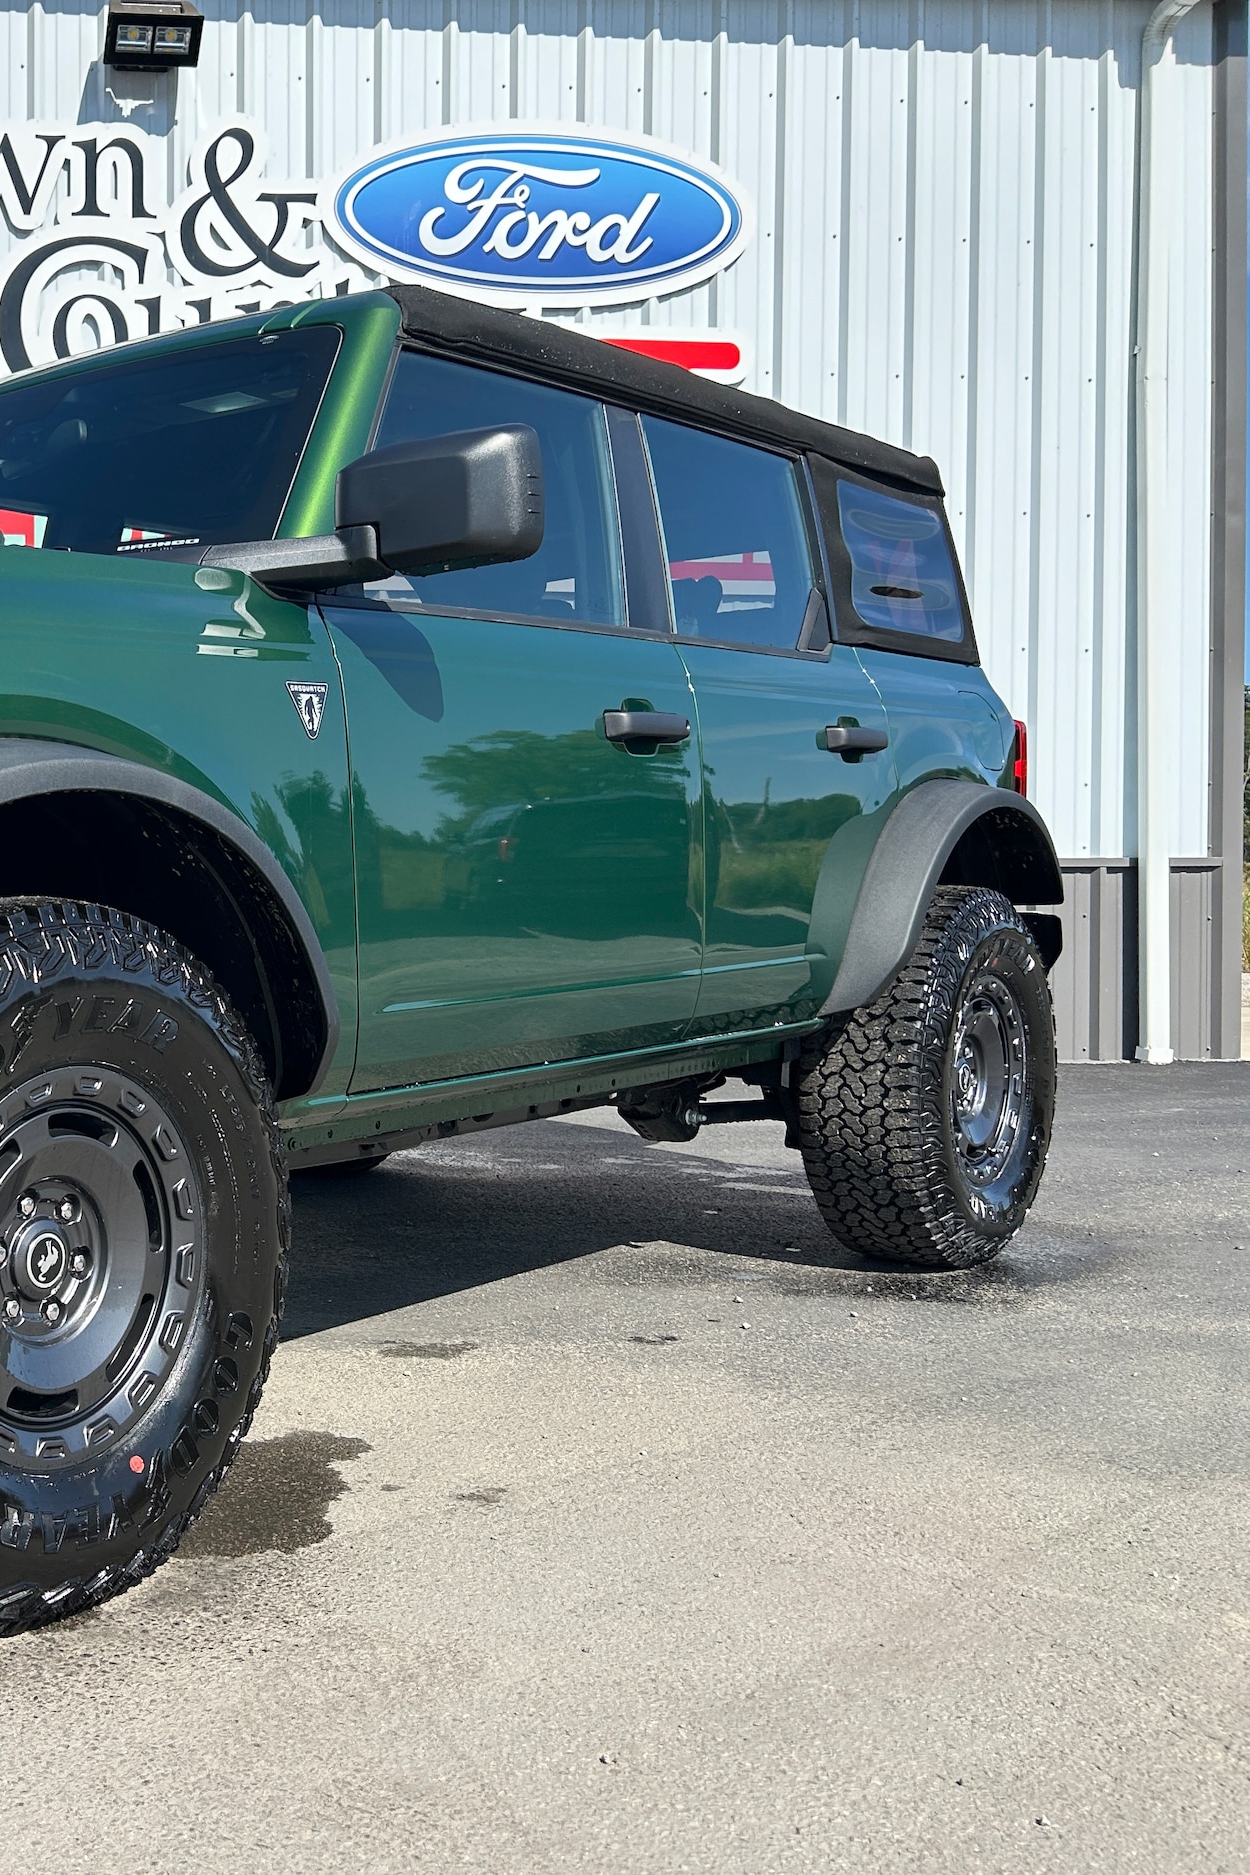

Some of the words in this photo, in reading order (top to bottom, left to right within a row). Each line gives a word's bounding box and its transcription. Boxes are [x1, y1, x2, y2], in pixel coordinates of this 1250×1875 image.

[180, 127, 320, 278] &
[419, 158, 662, 263] Ford
[290, 684, 326, 693] SASQUATCH
